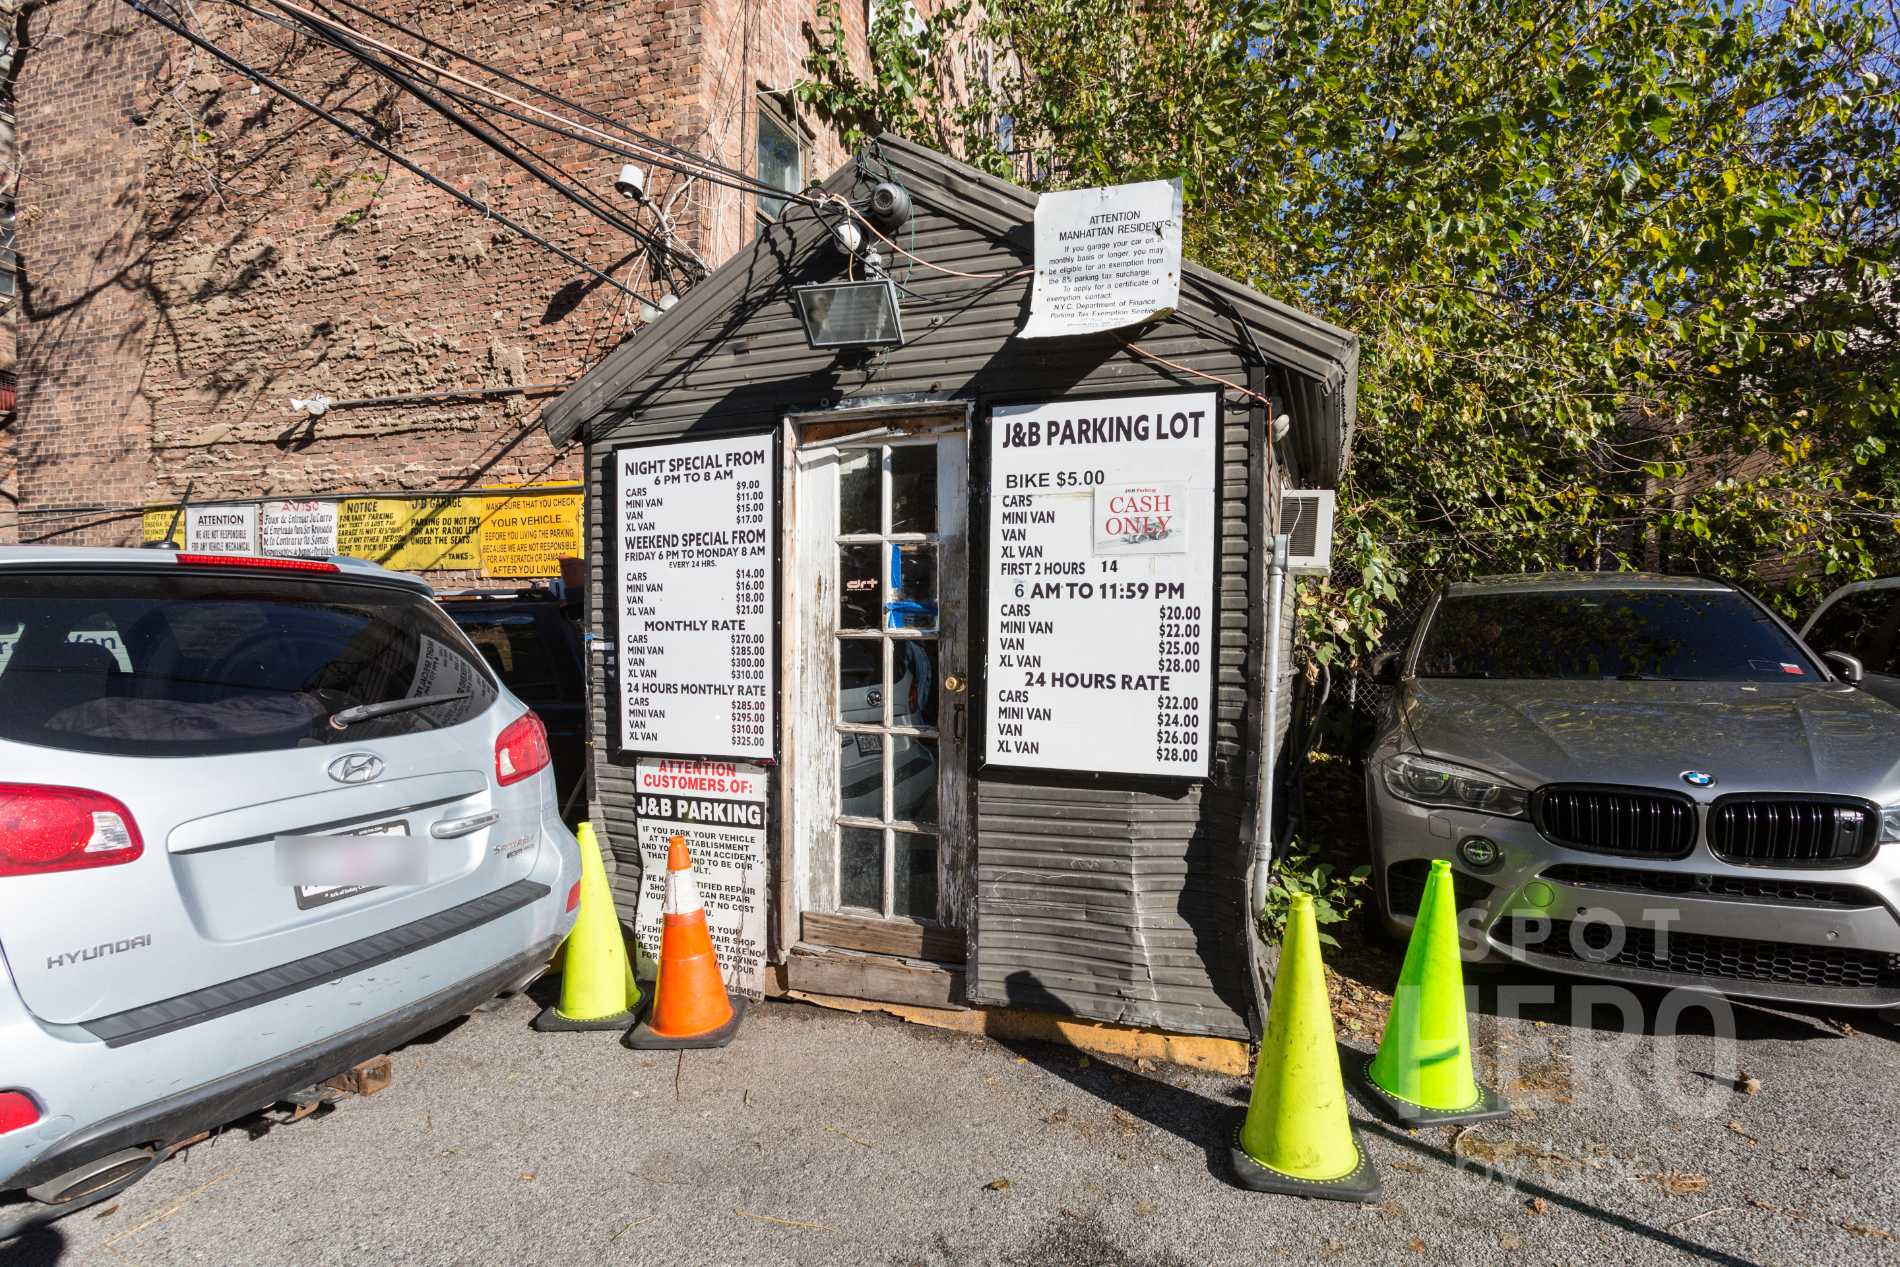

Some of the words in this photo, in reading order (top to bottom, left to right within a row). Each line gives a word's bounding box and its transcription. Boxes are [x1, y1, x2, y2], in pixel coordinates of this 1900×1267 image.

[1089, 210, 1141, 225] ATTENTION
[1059, 226, 1114, 241] MANHATTAN
[1117, 219, 1172, 234] RESIDENTS
[1087, 242, 1110, 252] garage
[1112, 240, 1128, 249] your
[1130, 238, 1142, 246] car
[1108, 259, 1144, 269] exemption
[1074, 274, 1099, 283] parking
[1002, 422, 1041, 448] J&B
[1047, 414, 1149, 446] PARKING
[1156, 411, 1205, 440] LOT
[625, 459, 666, 476] NIGHT
[669, 454, 722, 472] SPECIAL
[726, 449, 764, 467] FROM
[654, 476, 661, 485] 6
[664, 474, 680, 485] PM
[683, 472, 700, 483] TO
[704, 471, 711, 481] 8
[714, 469, 733, 480] AM
[1006, 473, 1050, 489] BIKE
[1057, 470, 1104, 488] $5.00
[626, 487, 647, 497] CARS
[736, 480, 760, 491] $9.00
[346, 501, 378, 513] NOTICE
[504, 500, 520, 510] SURE
[522, 500, 537, 509] THAT
[539, 499, 552, 507] YOU
[553, 497, 576, 506] CHECK
[626, 499, 643, 508] MINI
[645, 497, 663, 507] VAN
[736, 491, 763, 502] $11.00
[1002, 494, 1033, 508] CARS
[1109, 495, 1171, 514] CASH
[626, 511, 643, 520] VAN
[736, 502, 764, 513] $15.00
[1002, 511, 1027, 524] MINI
[1030, 511, 1055, 524] VAN
[198, 514, 244, 524] ATTENTION
[442, 517, 452, 526] DO
[454, 517, 467, 525] NOT
[468, 516, 480, 525] PAY
[491, 517, 518, 528] YOUR
[626, 523, 636, 532] XL
[638, 522, 655, 531] VAN
[736, 514, 763, 525] $17.00
[1105, 515, 1173, 536] ONLY
[426, 527, 439, 535] ANY
[442, 526, 463, 535] RADIO
[1001, 528, 1026, 541] VAN
[434, 536, 448, 544] THE
[450, 535, 473, 544] SEATS.
[625, 534, 679, 550] WEEKEND
[682, 531, 729, 547] SPECIAL
[732, 529, 766, 545] FROM
[625, 551, 656, 561] FRIDAY
[658, 551, 664, 560] 6
[666, 550, 679, 560] PM
[681, 549, 694, 559] TO
[697, 547, 739, 558] MONDAY
[741, 546, 747, 556] 8
[750, 546, 765, 556] AM
[1001, 546, 1015, 558] XL
[1018, 545, 1043, 558] VAN
[493, 565, 518, 574] AFTER
[519, 565, 535, 574] YOU
[536, 564, 561, 574] LIVING
[691, 560, 700, 568] 24
[1001, 562, 1032, 575] FIRST
[1035, 562, 1041, 575] 2
[1044, 562, 1085, 575] HOURS
[1102, 560, 1118, 573] 14
[626, 572, 647, 581] CARS
[736, 568, 765, 579] $14.00
[626, 584, 644, 593] MINI
[646, 583, 663, 592] VAN
[736, 580, 764, 591] $16.00
[1015, 584, 1024, 598] 6
[1030, 583, 1060, 599] AM
[1065, 582, 1093, 599] TO
[1099, 582, 1149, 599] 11:59
[1155, 582, 1184, 599] PM
[626, 596, 643, 604] VAN
[736, 592, 764, 603] $18.00
[627, 607, 637, 616] XL
[638, 607, 655, 615] VAN
[736, 604, 764, 615] $21.00
[1001, 604, 1031, 617] CARS
[1160, 605, 1201, 621] $20.00
[645, 620, 708, 631] MONTHLY
[712, 620, 746, 631] RATE
[1000, 621, 1025, 634] MINI
[1028, 621, 1053, 634] VAN
[1159, 622, 1200, 639] $22.00
[627, 634, 648, 643] CARS
[731, 634, 764, 644] $270.00
[1000, 637, 1024, 650] VAN
[1159, 640, 1199, 656] $25.00
[628, 646, 645, 655] MINI
[647, 646, 664, 655] VAN
[731, 646, 765, 656] $285.00
[628, 658, 645, 666] VAN
[731, 657, 765, 668] $300.00
[999, 654, 1013, 667] XL
[1016, 655, 1041, 668] VAN
[1158, 657, 1200, 673] $28.00
[628, 669, 638, 678] XL
[640, 669, 657, 678] VAN
[731, 669, 764, 680] $310.00
[1025, 672, 1046, 687] 24
[1051, 672, 1116, 689] HOURS
[1121, 674, 1170, 691] RATE
[627, 682, 639, 693] 24
[642, 683, 678, 694] HOURS
[681, 683, 735, 695] MONTHLY
[738, 685, 766, 696] RATE
[629, 697, 649, 706] CARS
[732, 700, 765, 711] $285.00
[999, 690, 1029, 703] CARS
[1158, 694, 1198, 710] $22.00
[629, 709, 646, 717] MINI
[648, 709, 665, 718] VAN
[732, 712, 765, 723] $295.00
[998, 706, 1023, 719] MINI
[1026, 707, 1051, 721] VAN
[1157, 711, 1199, 728] $24.00
[629, 720, 646, 729] VAN
[732, 724, 764, 735] $310.00
[998, 723, 1022, 736] VAN
[1157, 729, 1198, 745] $26.00
[629, 731, 639, 741] XL
[640, 732, 657, 741] VAN
[732, 736, 764, 746] $325.00
[997, 740, 1011, 753] XL
[1014, 741, 1039, 754] VAN
[1156, 746, 1198, 762] $28.00
[658, 759, 737, 777] ATTENTION
[643, 773, 725, 793] CUSTOMERS
[730, 779, 753, 794] OF:
[637, 796, 672, 817] J&B
[676, 799, 761, 825] PARKING
[651, 826, 668, 835] YOU
[670, 827, 691, 837] PARK
[693, 831, 717, 840] YOUR
[719, 833, 756, 844] VEHICLE
[700, 850, 712, 858] AN
[47, 933, 152, 970] HYUNDAI
